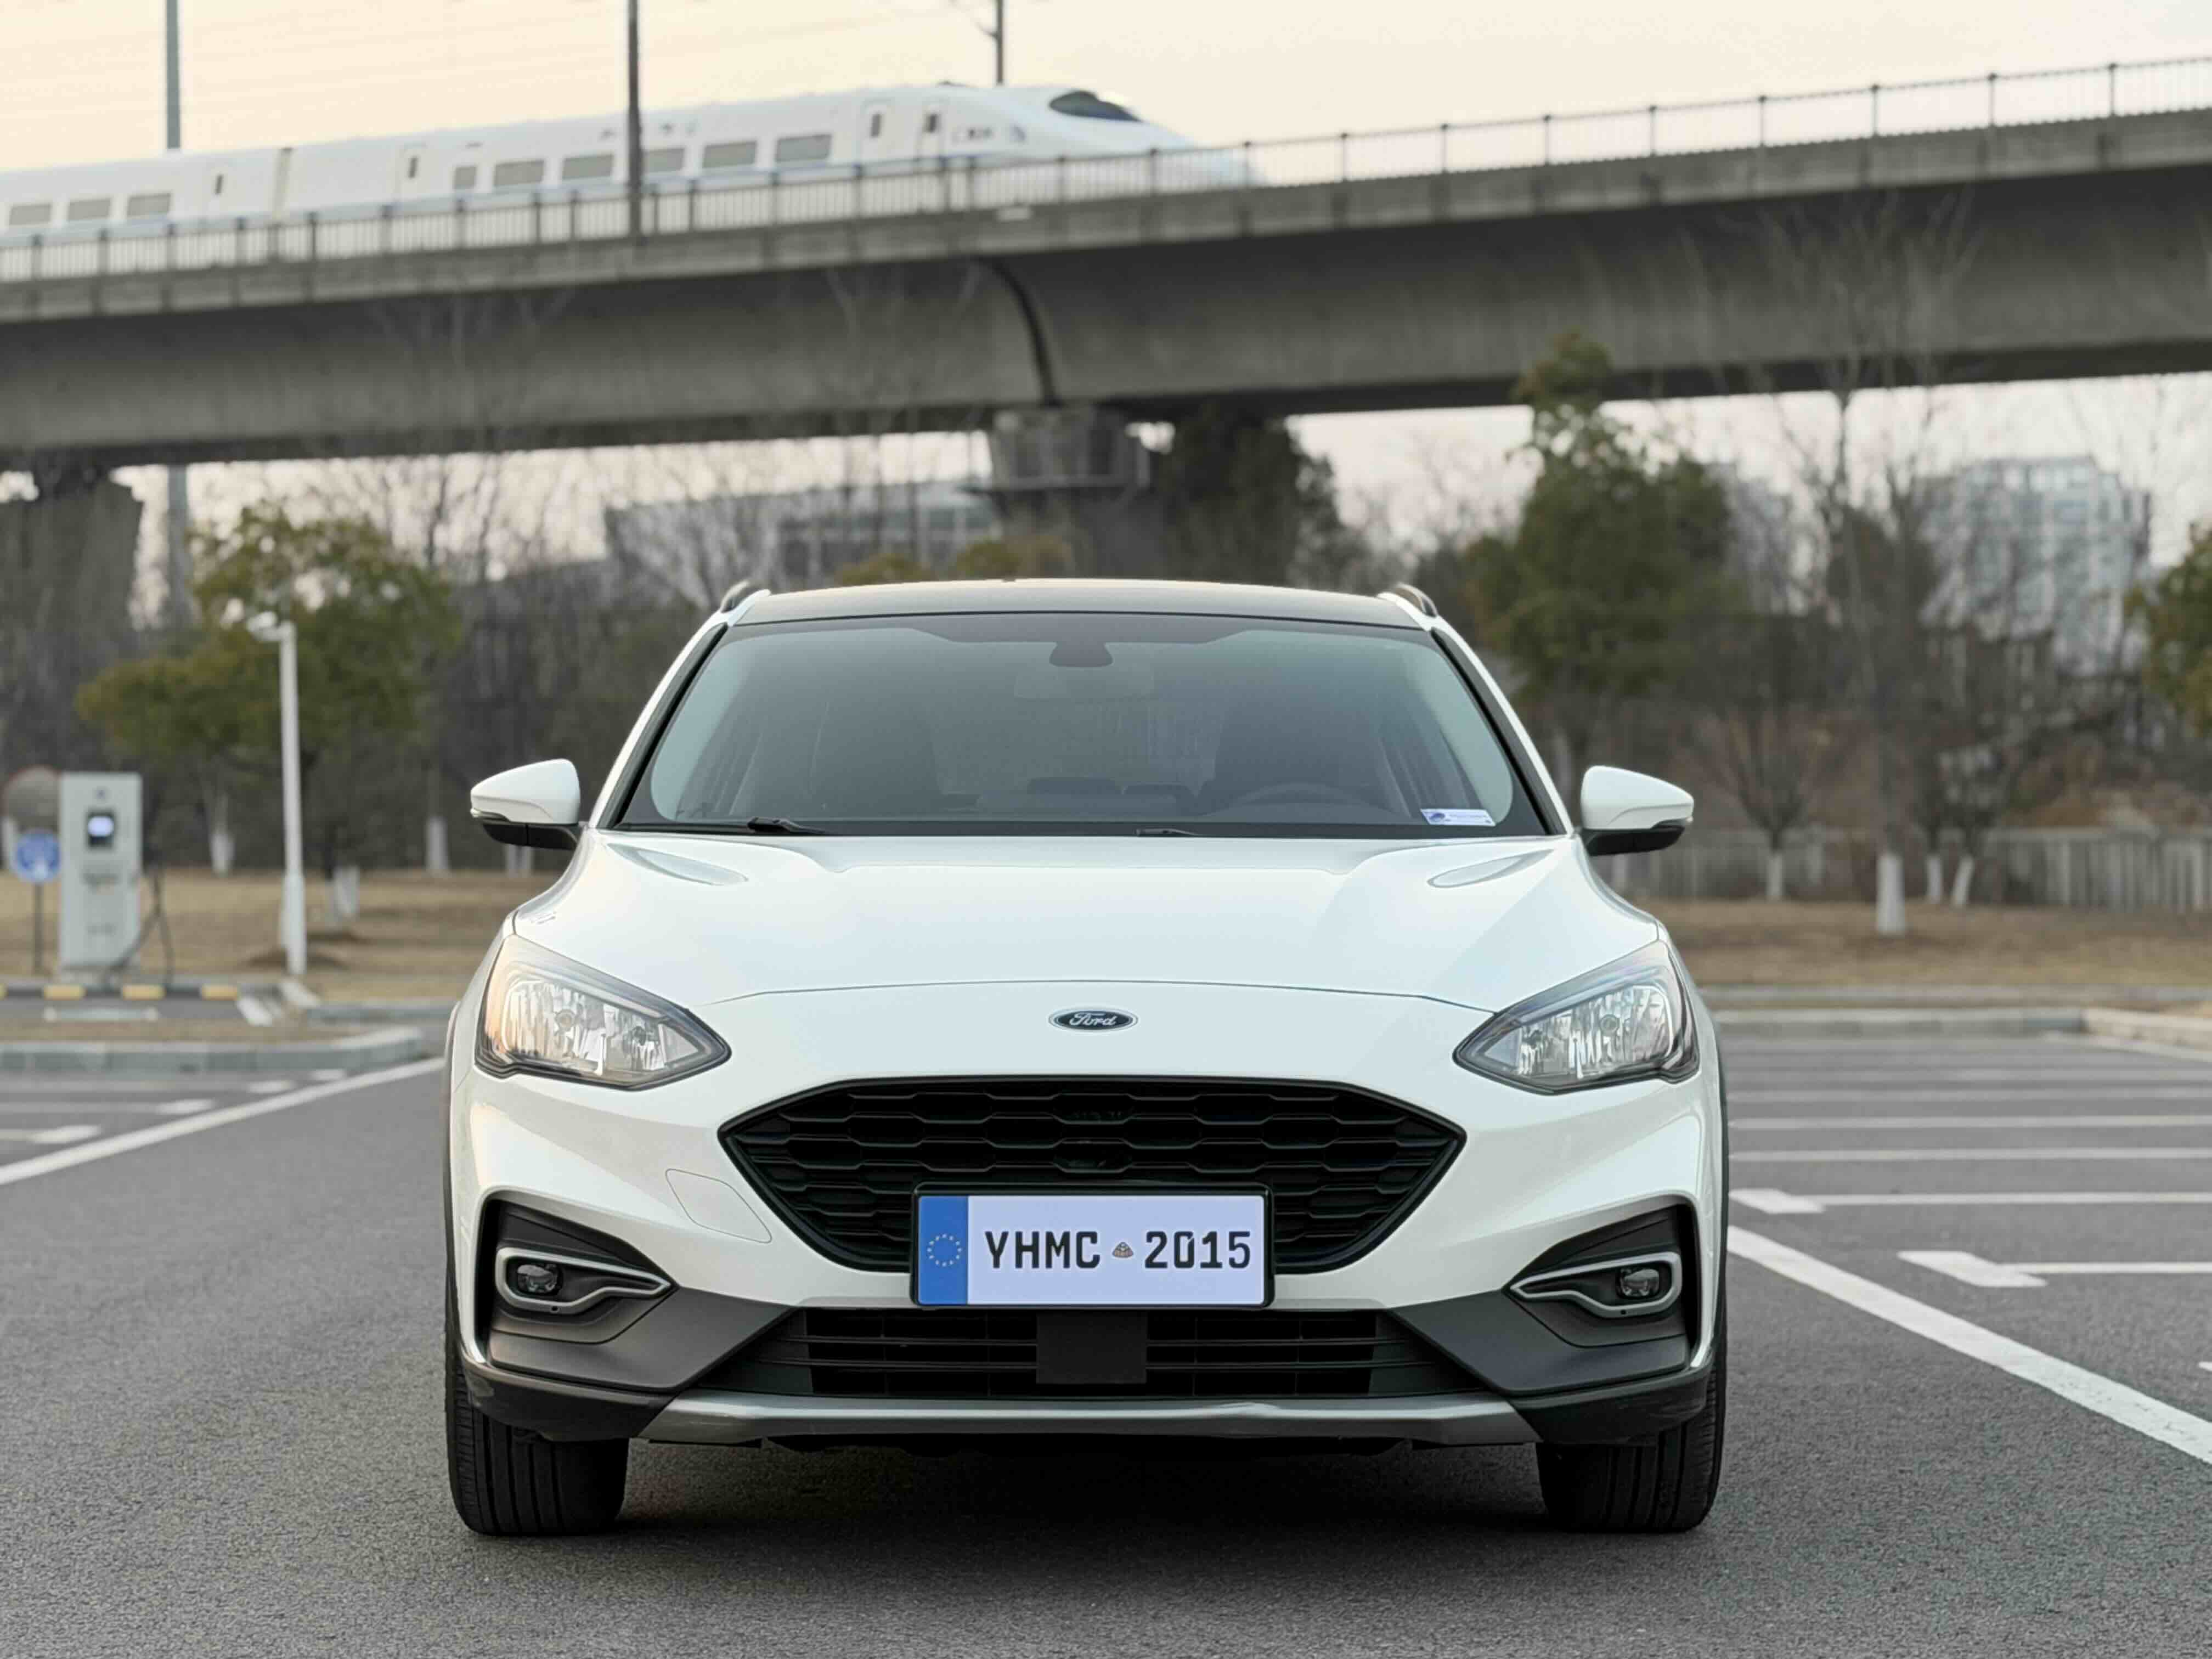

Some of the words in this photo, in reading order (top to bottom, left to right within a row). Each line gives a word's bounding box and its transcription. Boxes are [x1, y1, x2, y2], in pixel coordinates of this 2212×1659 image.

[1069, 1013, 1117, 1025] Ford
[985, 1231, 1101, 1268] YHMC
[1144, 1231, 1251, 1268] 2015
